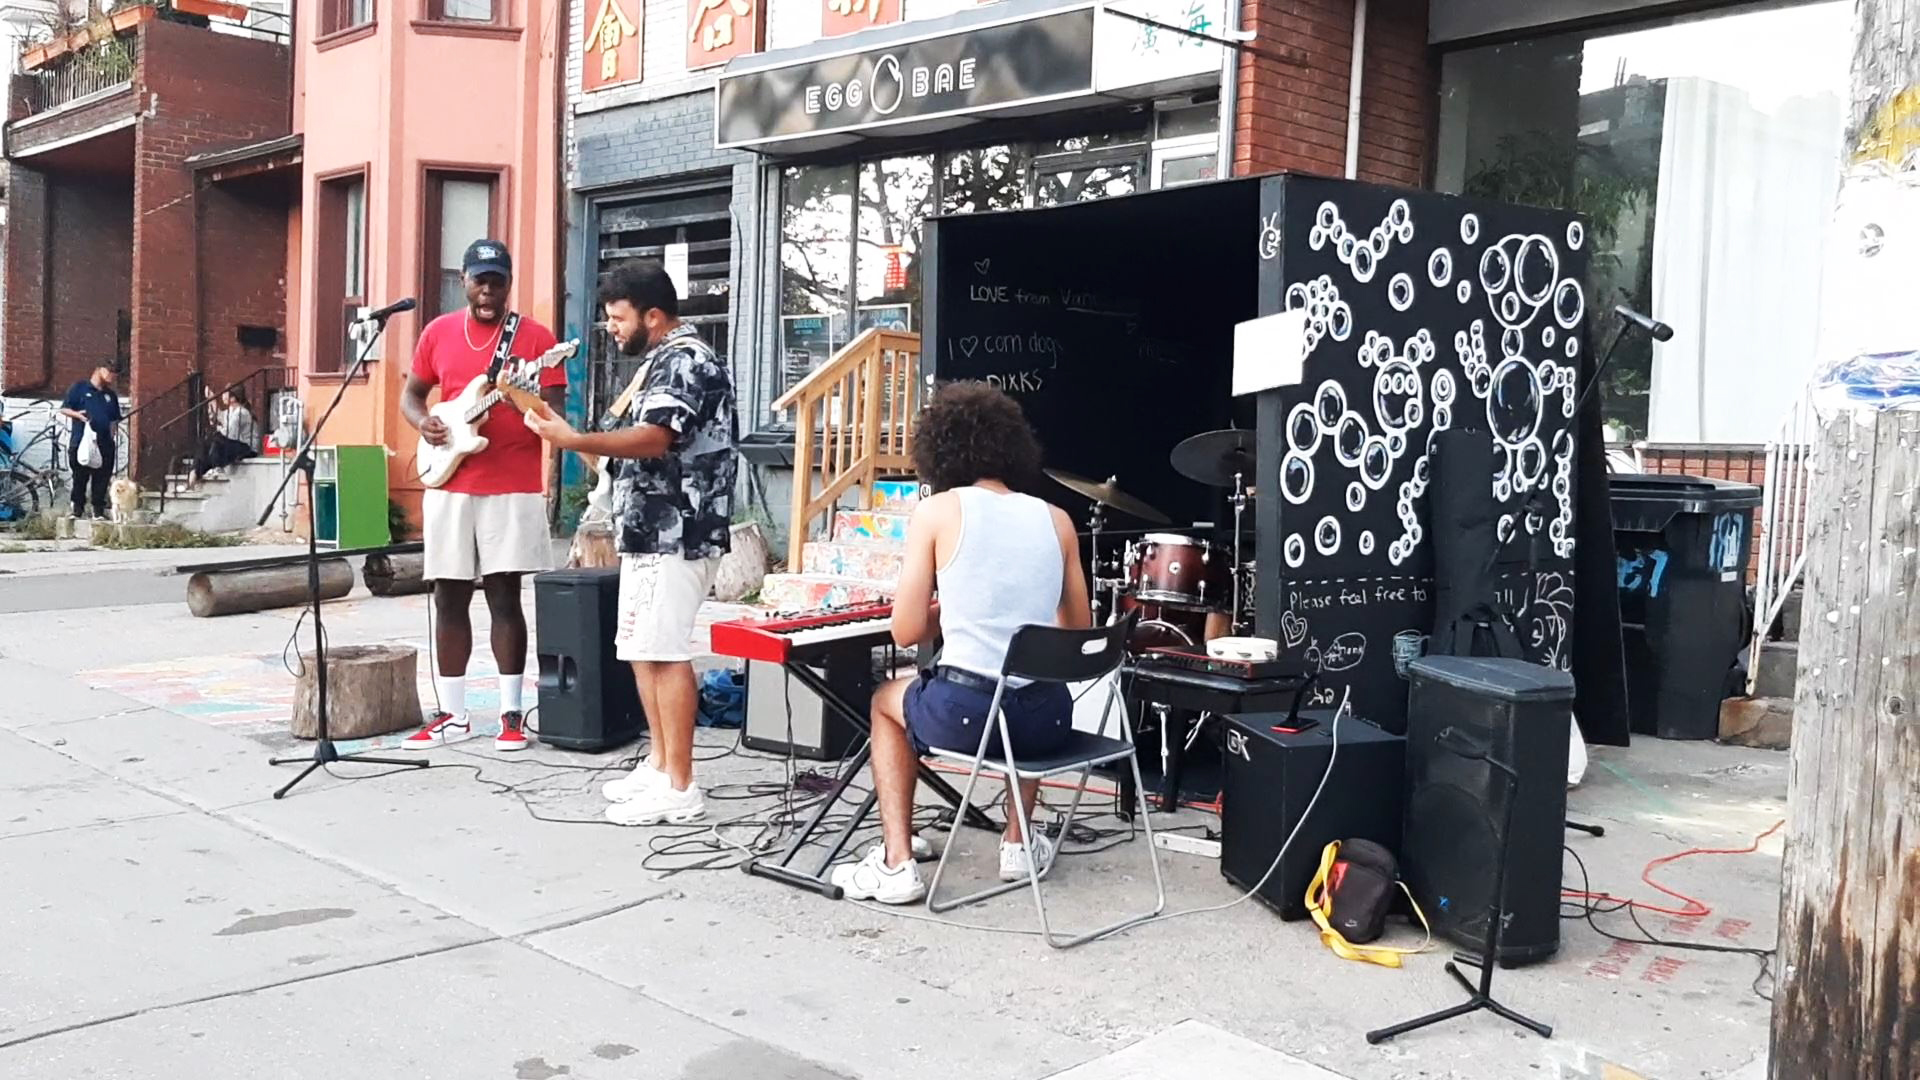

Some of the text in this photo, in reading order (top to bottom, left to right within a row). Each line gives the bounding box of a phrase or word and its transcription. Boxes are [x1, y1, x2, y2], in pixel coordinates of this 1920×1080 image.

[805, 57, 977, 114] EGG BAE
[970, 284, 1009, 303] LOVE
[1015, 288, 1050, 305] from
[1290, 591, 1332, 611] Please
[1340, 588, 1367, 606] feel
[1375, 585, 1406, 602] free
[1411, 586, 1427, 601] to
